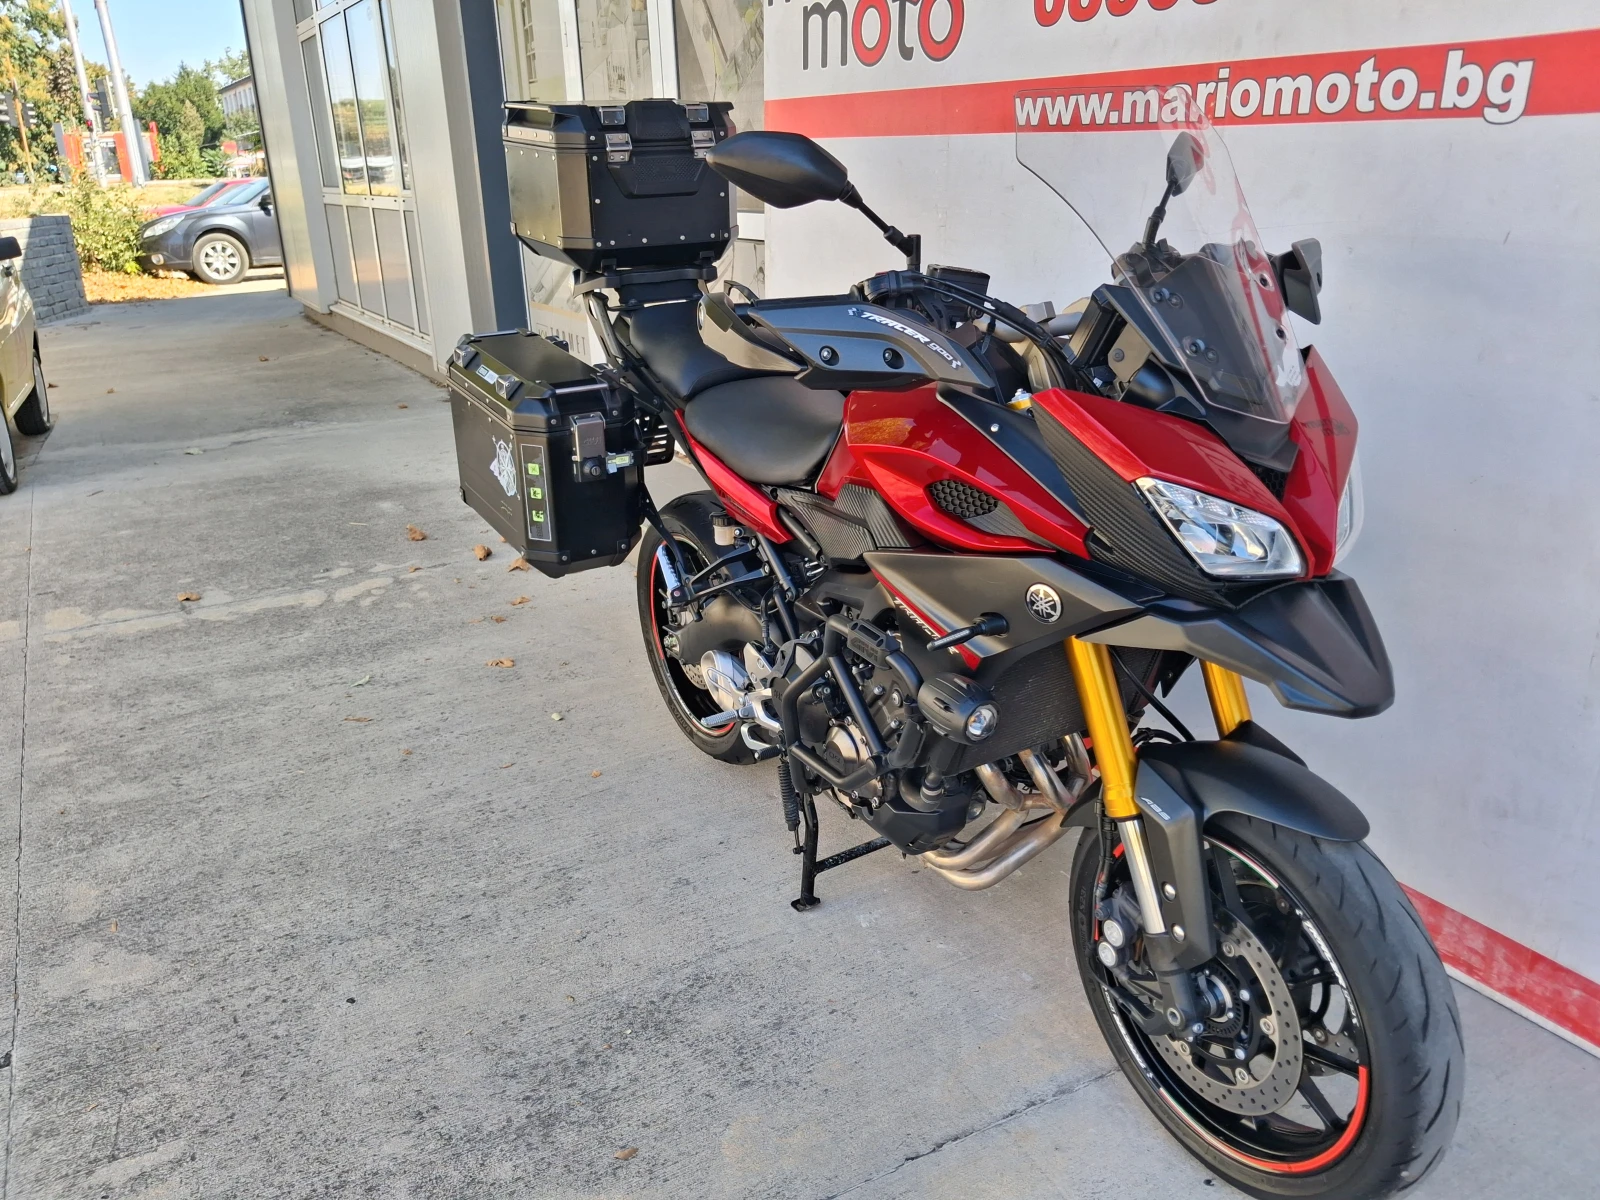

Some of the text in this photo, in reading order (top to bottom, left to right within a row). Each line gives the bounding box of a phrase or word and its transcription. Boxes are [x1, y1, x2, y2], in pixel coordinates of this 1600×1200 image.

[802, 0, 965, 71] moto
[1015, 49, 1536, 126] www.mariomoto.bg
[860, 311, 954, 361] TRACER 900
[1139, 796, 1172, 821] ABS
